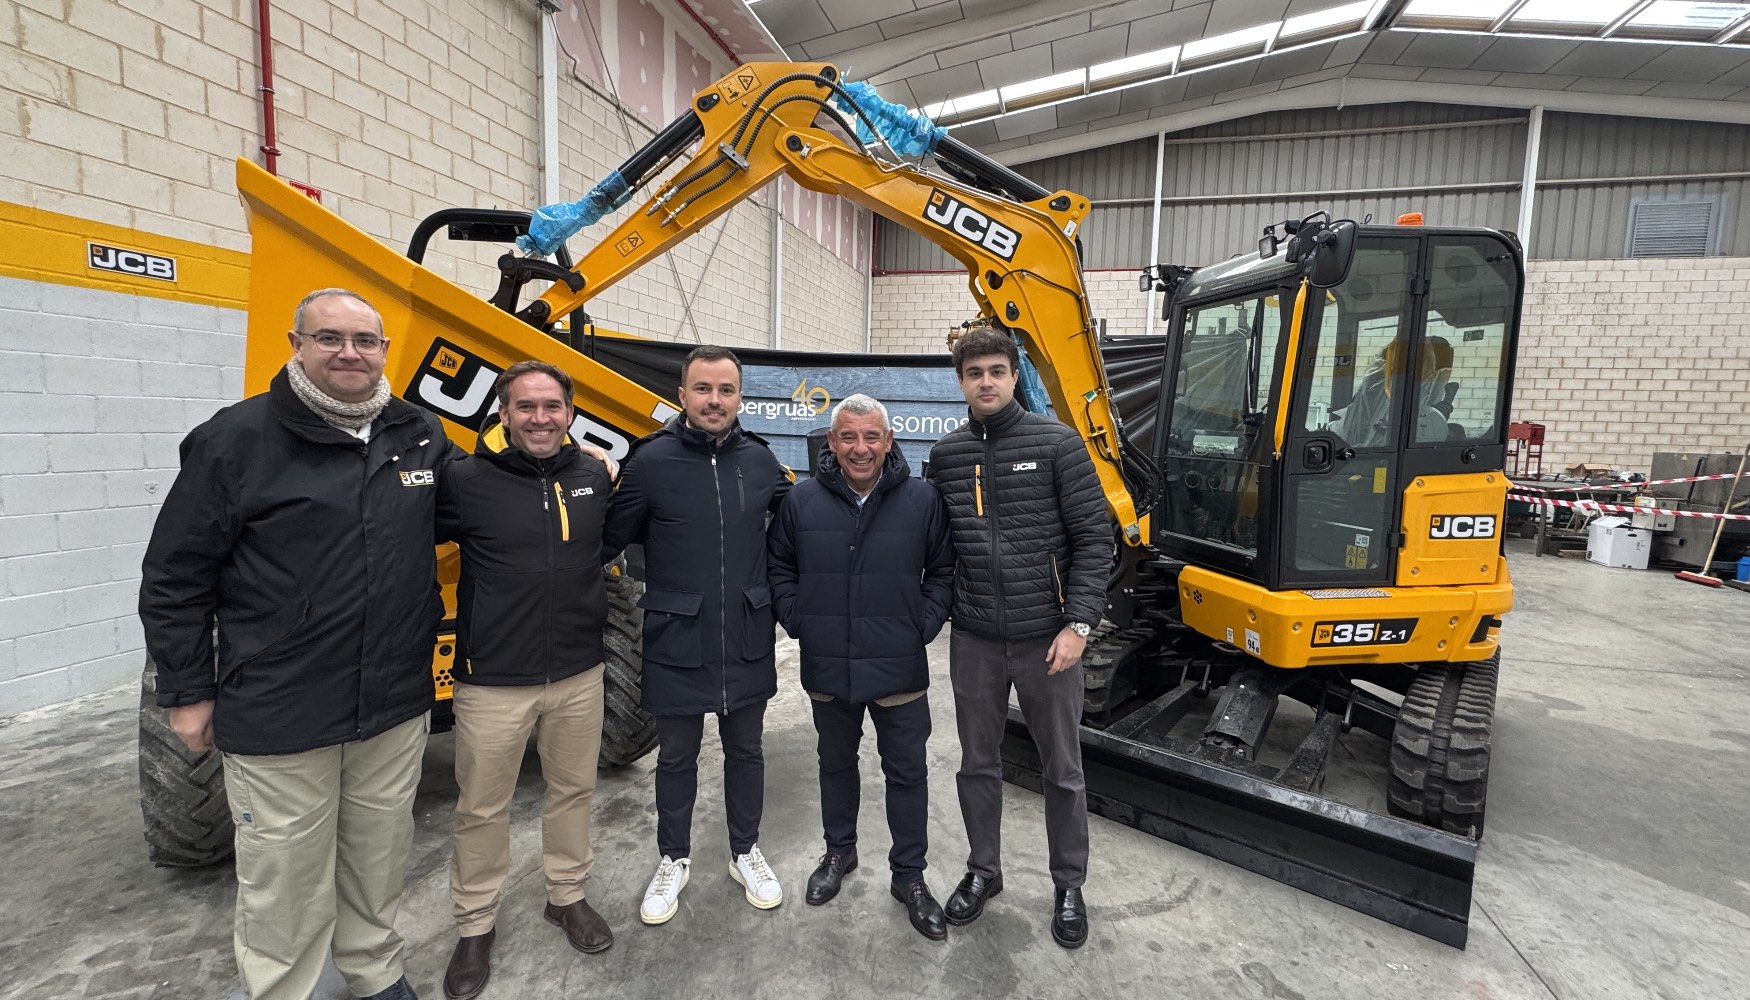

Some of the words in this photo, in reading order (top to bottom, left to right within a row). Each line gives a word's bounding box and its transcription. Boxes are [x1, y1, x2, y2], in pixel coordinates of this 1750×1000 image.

[927, 199, 1017, 258] JCB
[93, 249, 172, 278] JCB
[418, 365, 630, 472] JB
[1012, 461, 1037, 471] JCB
[401, 470, 434, 485] JCB
[571, 487, 594, 497] JCB
[1431, 516, 1495, 538] JCB
[1333, 623, 1375, 643] 35
